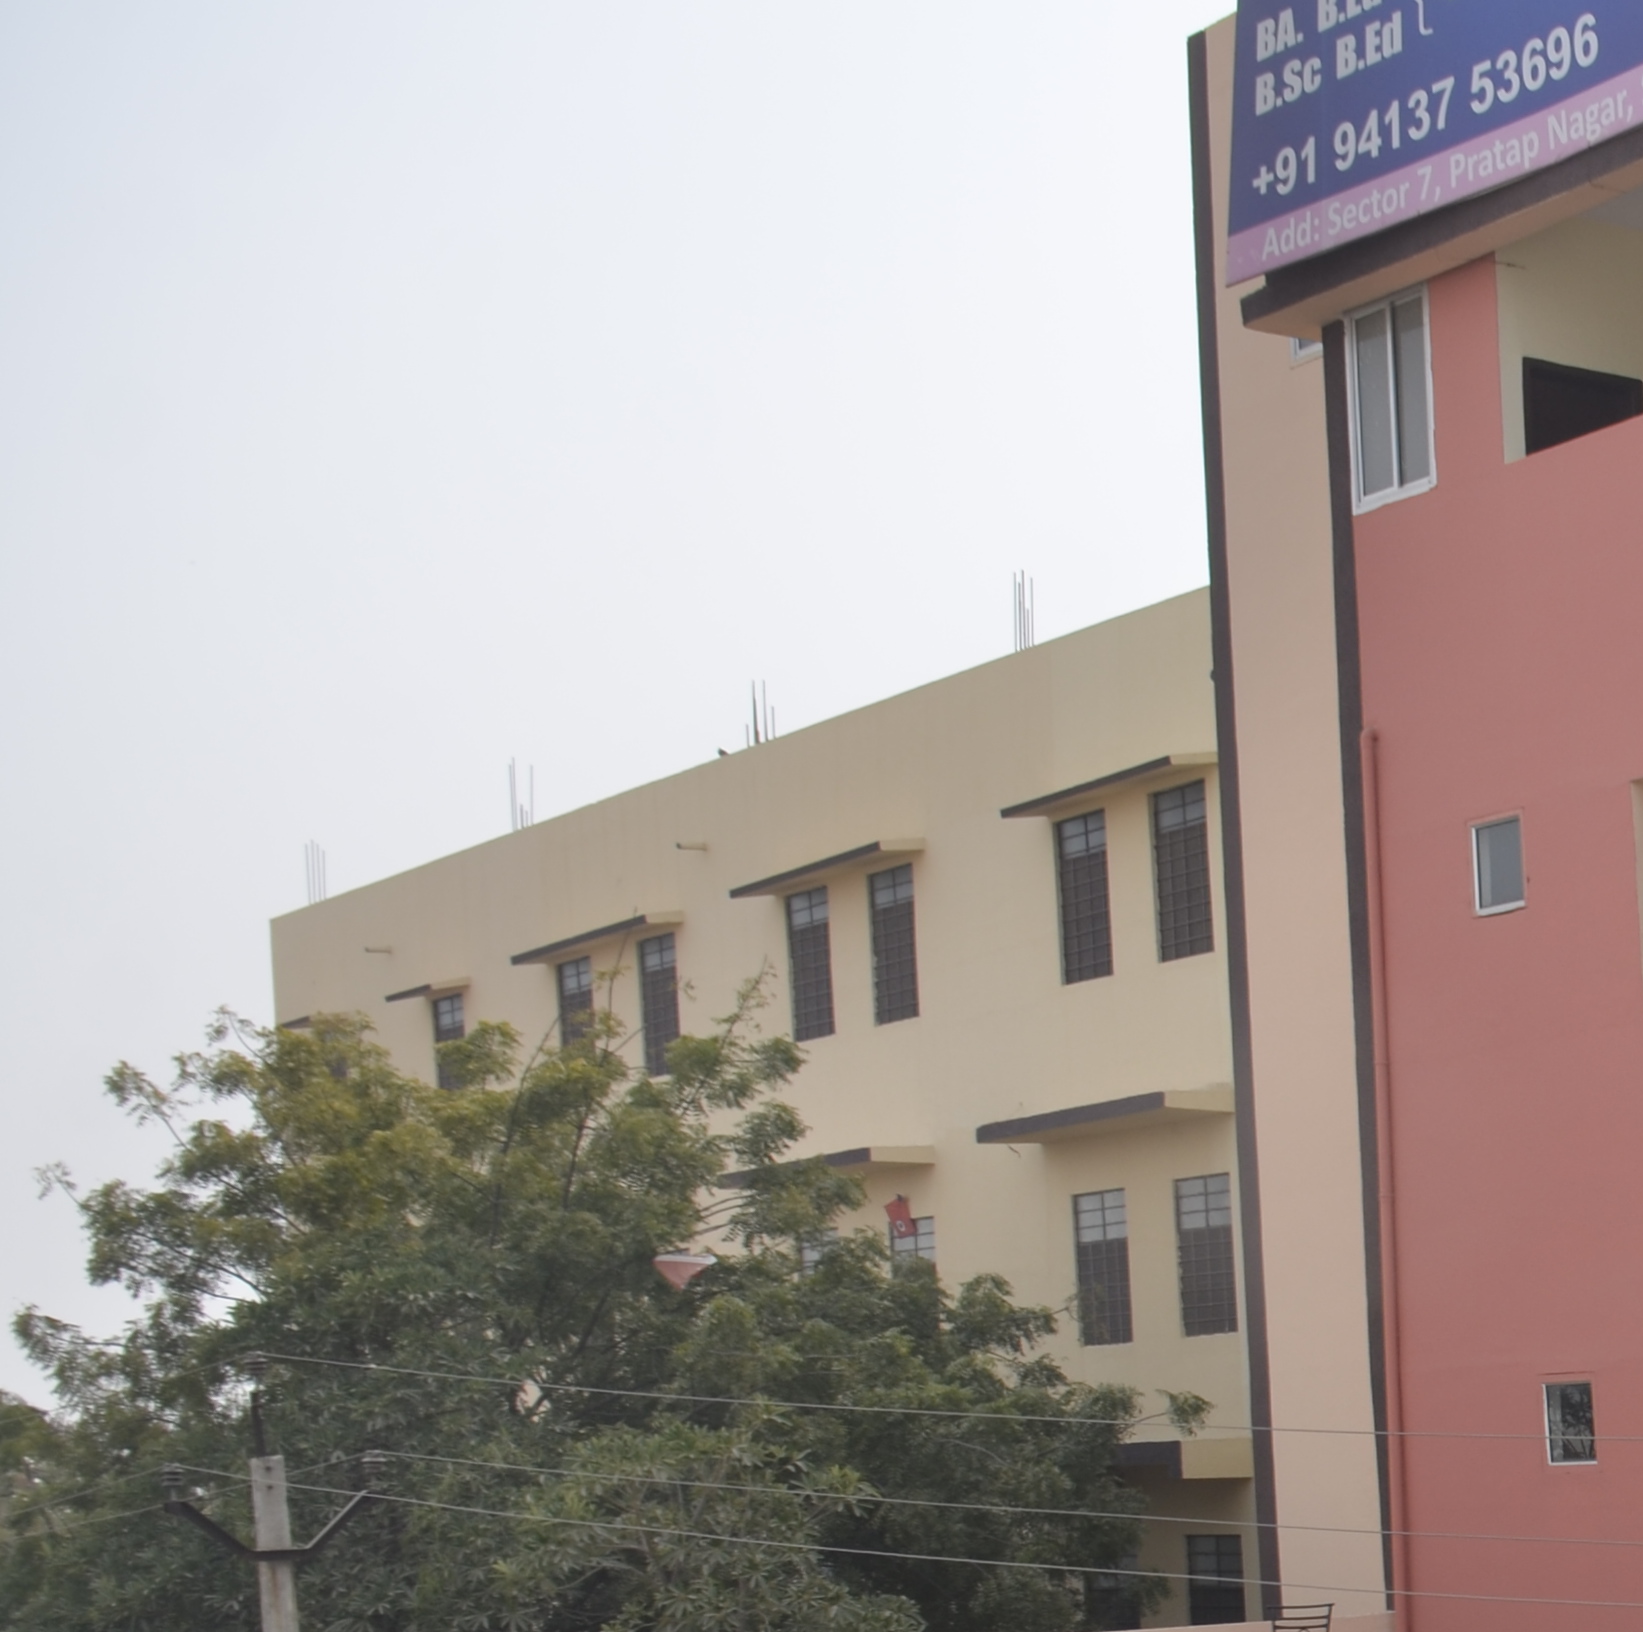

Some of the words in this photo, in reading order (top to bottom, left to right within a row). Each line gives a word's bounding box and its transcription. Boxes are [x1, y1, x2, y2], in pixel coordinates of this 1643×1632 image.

[1252, 135, 1317, 196] +91
[1333, 76, 1456, 172] 94137
[1469, 12, 1599, 114] 53696
[1255, 56, 1322, 116] B.Sc
[1336, 9, 1403, 80] B.Ed
[1256, 7, 1304, 62] BA.
[1261, 216, 1320, 260] Add:
[1327, 180, 1411, 236] Sector
[1416, 165, 1441, 203] 7,
[1448, 132, 1540, 189] Pratap
[1548, 88, 1634, 150] Nagar,
